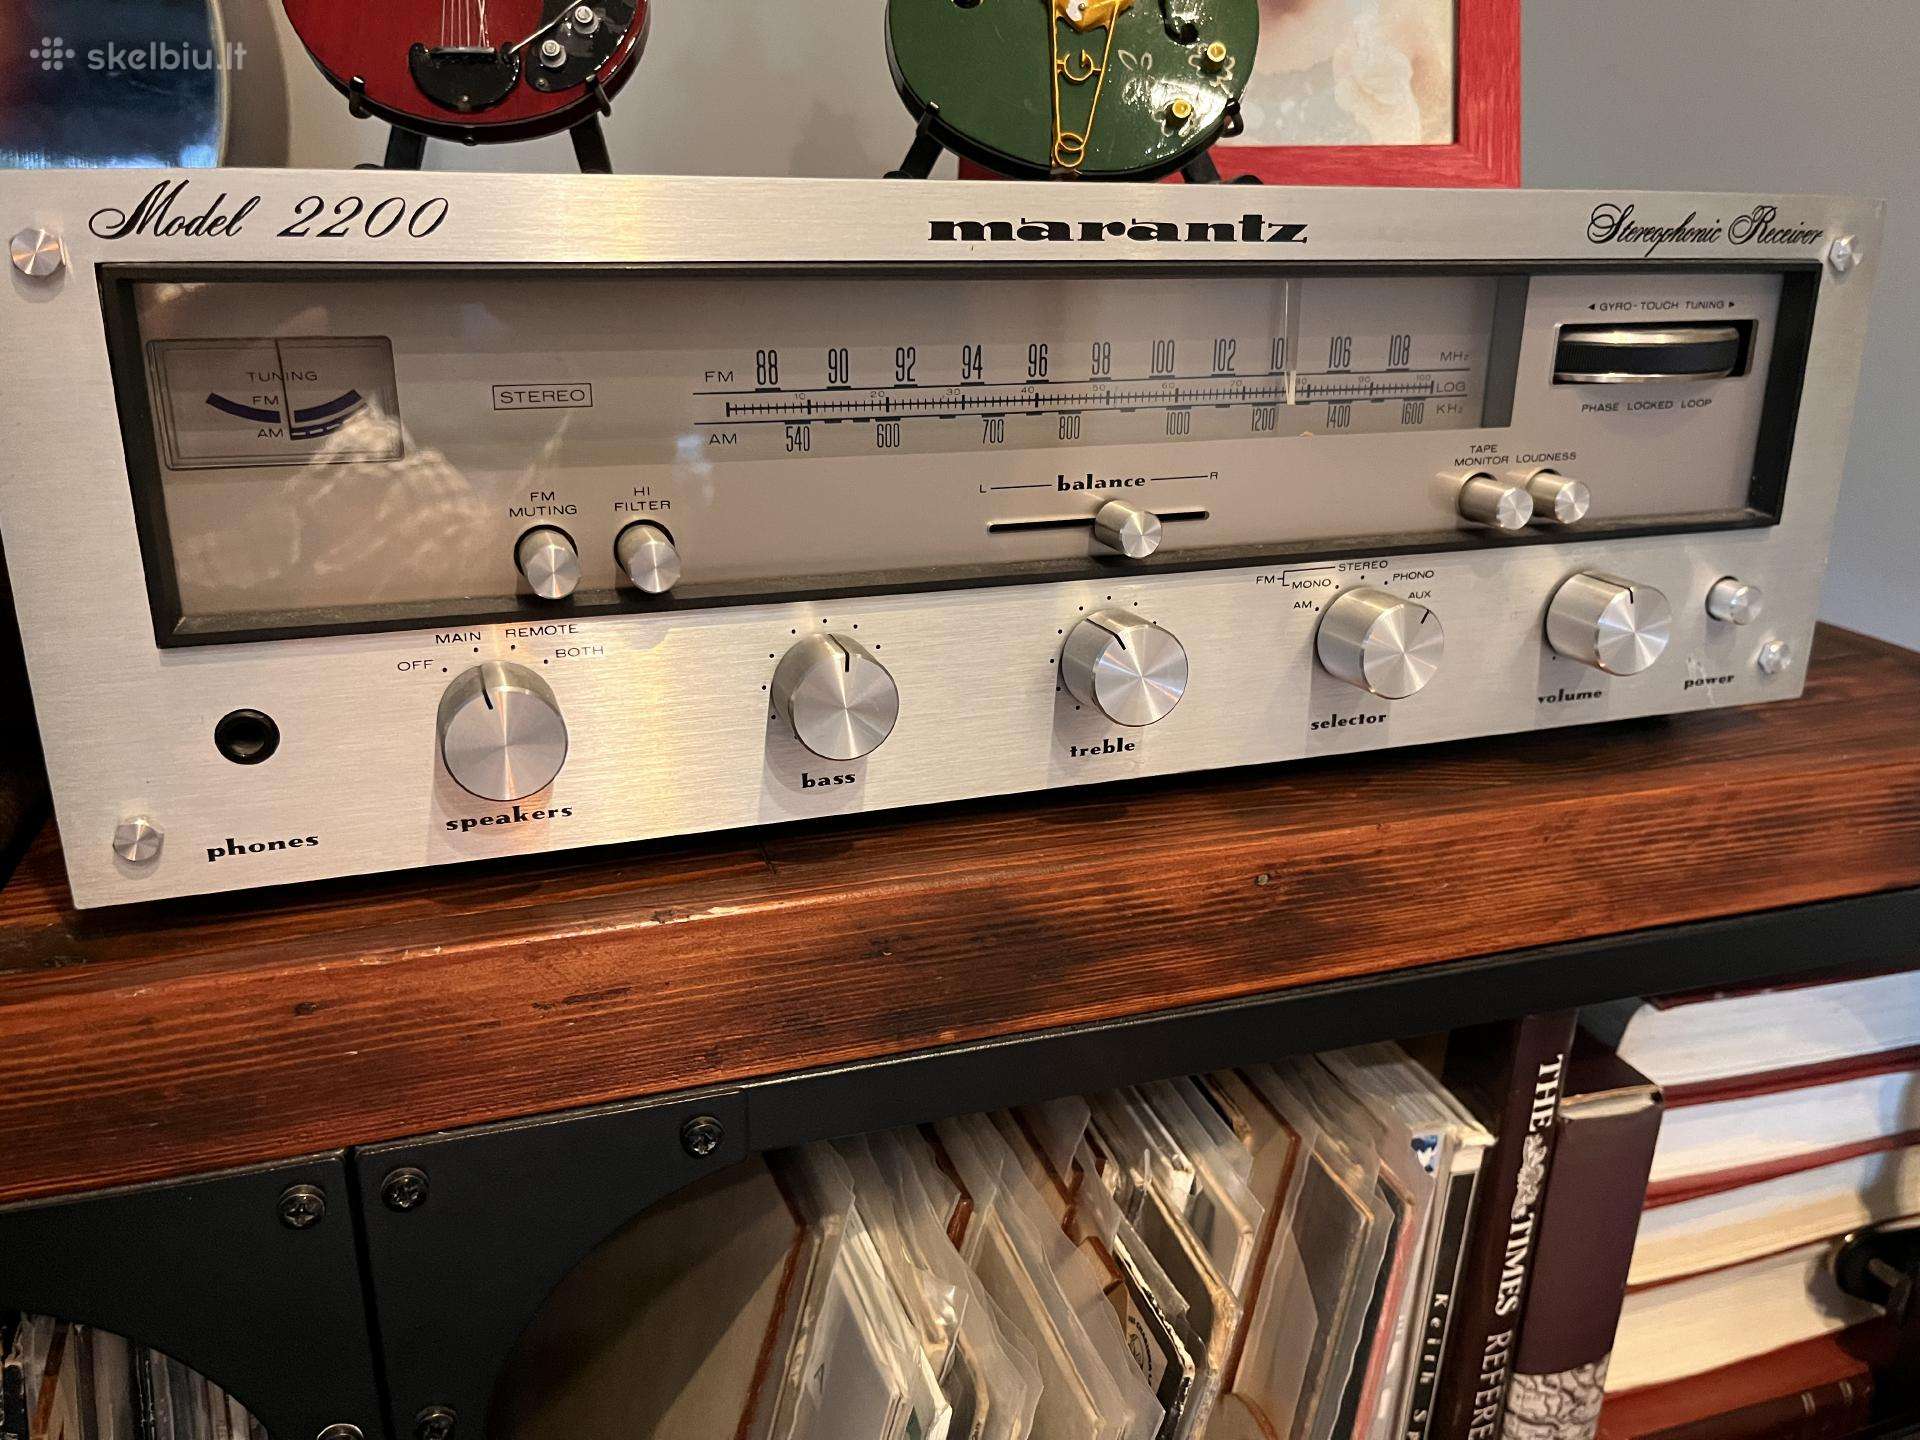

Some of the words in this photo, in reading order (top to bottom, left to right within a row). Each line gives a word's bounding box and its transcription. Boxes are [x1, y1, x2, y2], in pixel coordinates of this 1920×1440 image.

[88, 179, 261, 239] Model
[276, 196, 450, 238] 2200
[927, 214, 1309, 244] marantz
[1586, 203, 1723, 258] Stereophonic
[1727, 205, 1824, 245] Receiver
[1684, 300, 1725, 311] TUNING
[705, 370, 734, 383] FM
[755, 349, 779, 386] 88
[828, 348, 849, 384] 90
[895, 346, 916, 382] 92
[962, 344, 983, 380] 94
[1028, 343, 1047, 378] 96
[1092, 341, 1111, 375] 98
[1151, 339, 1175, 374] 100
[1212, 338, 1236, 372] 102
[1270, 337, 1287, 370] 10
[1328, 336, 1352, 368] 106
[1388, 334, 1411, 366] 108
[1440, 352, 1470, 361] MHz
[246, 371, 318, 382] TUNING
[500, 389, 585, 404] STEREO
[793, 392, 806, 400] 10
[870, 390, 885, 398] 20
[946, 388, 961, 396] 30
[1020, 386, 1035, 394] 40
[1092, 384, 1106, 392] 50
[1162, 382, 1175, 390] 60
[1436, 381, 1466, 393] LOG
[252, 395, 279, 405] FM
[1581, 401, 1621, 413] PHASE
[1627, 400, 1675, 411] LOCKED
[1680, 398, 1712, 410] LOOP
[257, 428, 284, 438] AM
[709, 433, 737, 445] AM
[785, 424, 811, 452] 540
[876, 422, 900, 448] 600
[982, 419, 1004, 444] 700
[1059, 416, 1080, 440] 800
[1166, 411, 1190, 435] 1000
[1251, 407, 1275, 432] 1200
[1326, 404, 1351, 429] 1400
[1401, 402, 1424, 425] 1600
[1436, 404, 1463, 414] KHz
[1470, 444, 1498, 454] TAPE
[1454, 455, 1510, 467] MONITOR
[1516, 451, 1577, 464] LOUDNESS
[979, 484, 987, 494] L
[1057, 474, 1146, 493] balance
[1209, 471, 1219, 481] R
[530, 491, 555, 502] FM
[633, 487, 651, 497] HI
[509, 504, 578, 519] MUTING
[613, 499, 671, 513] FILTER
[1338, 560, 1389, 572] STEREO
[1256, 575, 1275, 584] FM
[1291, 579, 1332, 589] MONO
[1393, 570, 1435, 582] PHONO
[1408, 590, 1432, 599] AUX
[1293, 600, 1312, 609] AM
[435, 631, 481, 644] MAIN
[505, 624, 579, 638] REMOTE
[555, 645, 604, 659] BOTH
[397, 660, 434, 672] OFF
[1683, 674, 1735, 690] power
[1537, 688, 1602, 704] volume
[1311, 713, 1387, 731] selector
[1070, 737, 1136, 758] treble
[801, 771, 856, 789] bass
[445, 804, 573, 833] speakers
[206, 834, 319, 862] phones
[1528, 1053, 1564, 1133] THE
[1494, 1211, 1535, 1317] TIMES
